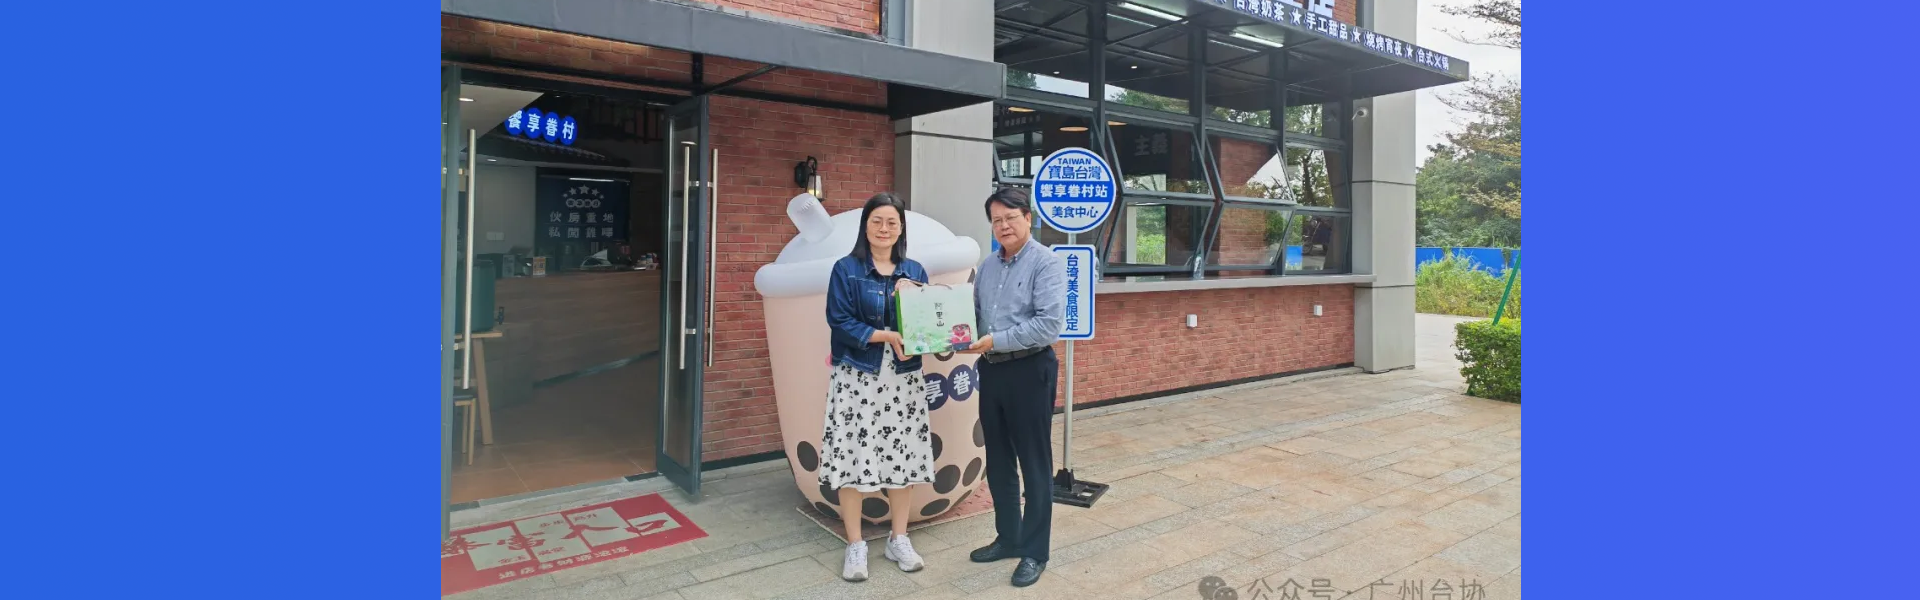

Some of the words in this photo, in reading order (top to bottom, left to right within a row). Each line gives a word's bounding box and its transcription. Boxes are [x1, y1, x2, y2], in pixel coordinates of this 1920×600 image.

[1306, 12, 1348, 40] 手工甜品
[1365, 31, 1402, 57] 烧烤宵夜
[1417, 48, 1449, 71] 台式火锅
[1057, 157, 1092, 165] TAIWAN
[1049, 166, 1101, 180] 寶島台灣
[1040, 184, 1108, 198] 饗享眷村站
[1051, 206, 1099, 219] 美食中心
[1066, 254, 1079, 331] 台湾美食限定
[926, 371, 979, 403] 享眷
